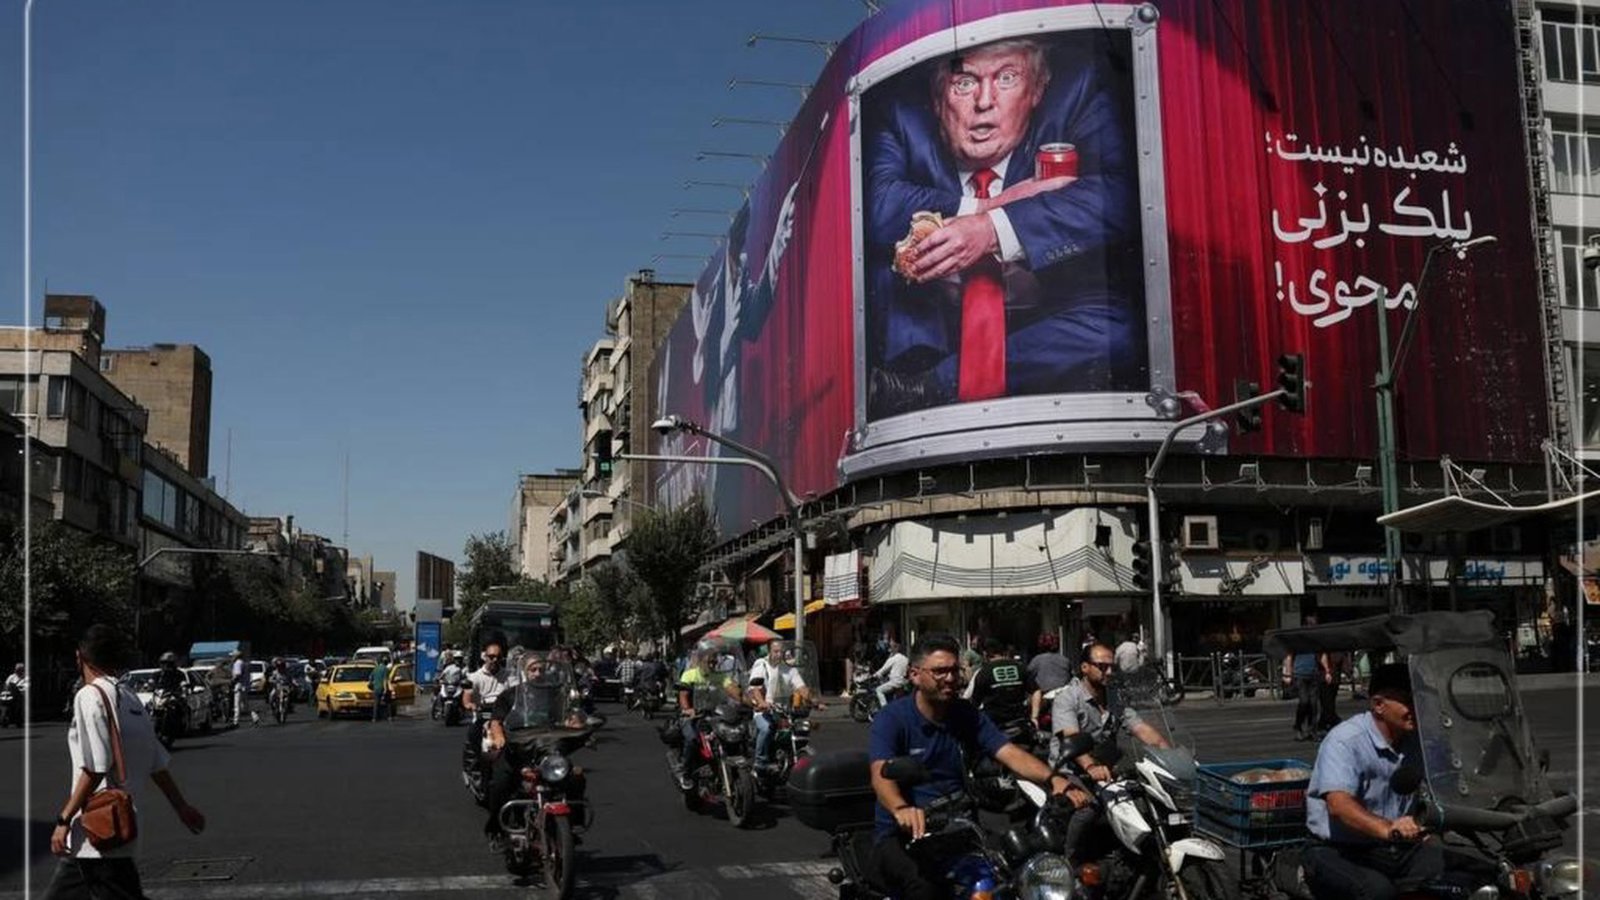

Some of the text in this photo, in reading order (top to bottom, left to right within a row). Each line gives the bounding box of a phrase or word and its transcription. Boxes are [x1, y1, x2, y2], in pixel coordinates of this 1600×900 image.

[1374, 141, 1467, 179] شعبده
[1272, 181, 1472, 259] پلک بزنی
